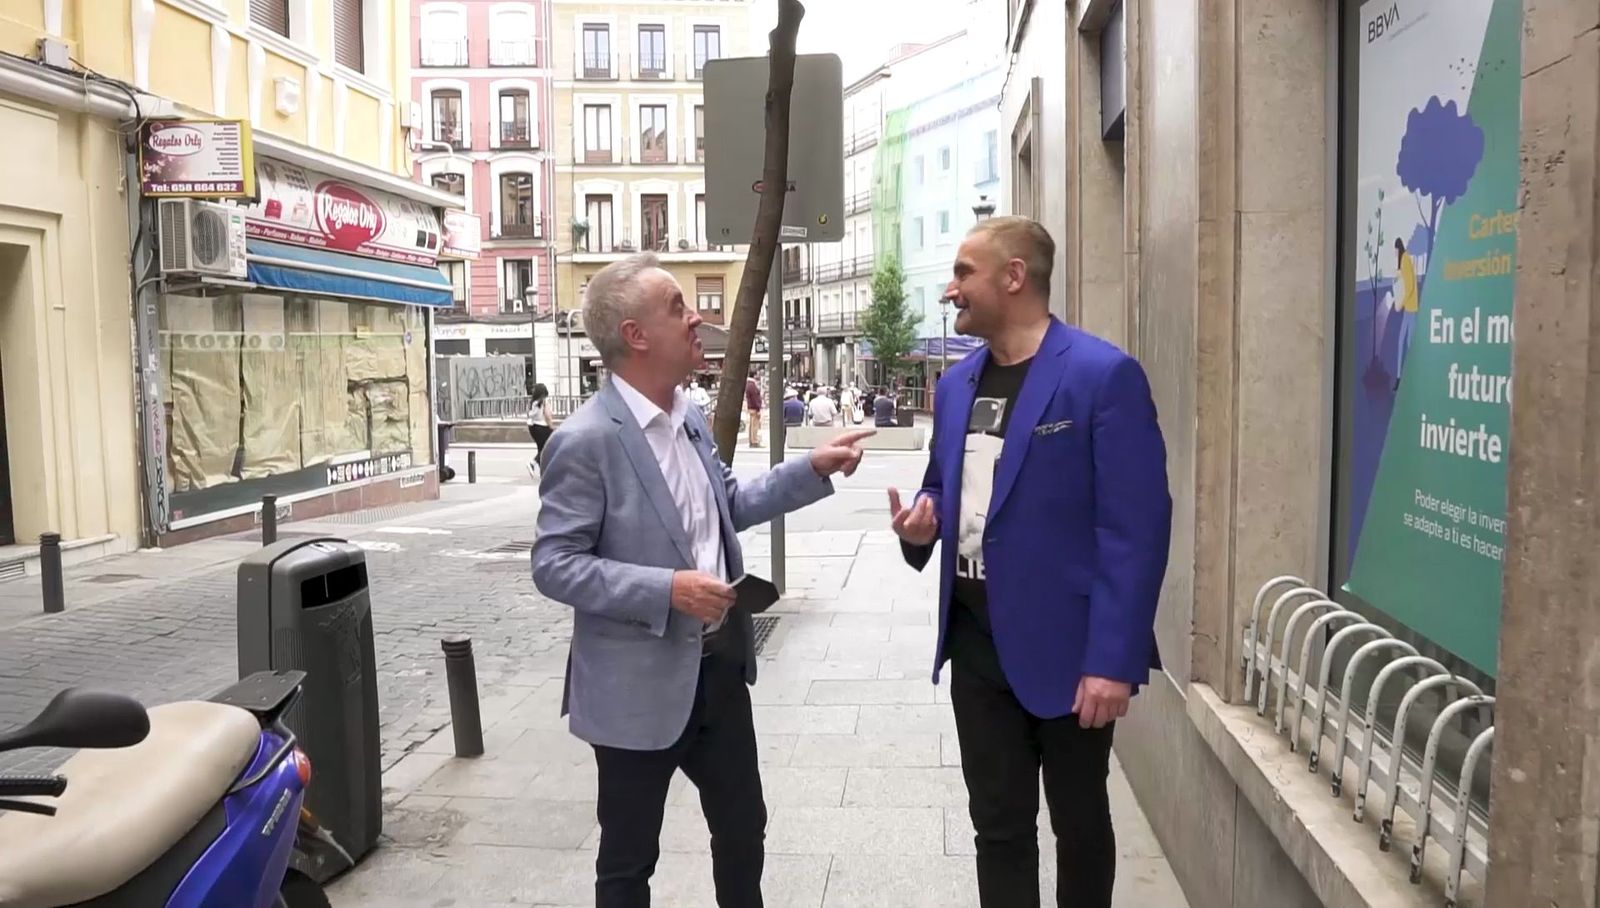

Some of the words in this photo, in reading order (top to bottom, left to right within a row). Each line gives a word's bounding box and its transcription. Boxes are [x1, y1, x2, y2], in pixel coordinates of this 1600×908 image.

[1368, 2, 1400, 43] BBVA
[152, 134, 182, 149] Regalos
[184, 133, 202, 149] Orly
[151, 184, 170, 192] Tel:
[171, 183, 192, 192] 658
[217, 183, 237, 191] 632
[324, 193, 359, 230] Regalos
[1429, 308, 1454, 344] En
[1460, 307, 1480, 344] el
[1420, 414, 1502, 463] invierte
[1414, 488, 1440, 512] Poder
[1440, 498, 1467, 523] elegir
[1468, 505, 1477, 525] la
[1403, 512, 1413, 527] se
[1413, 515, 1443, 538] adapte
[1444, 527, 1451, 541] a
[1452, 526, 1459, 544] ti
[1460, 534, 1472, 549] es
[1473, 534, 1503, 561] hacer
